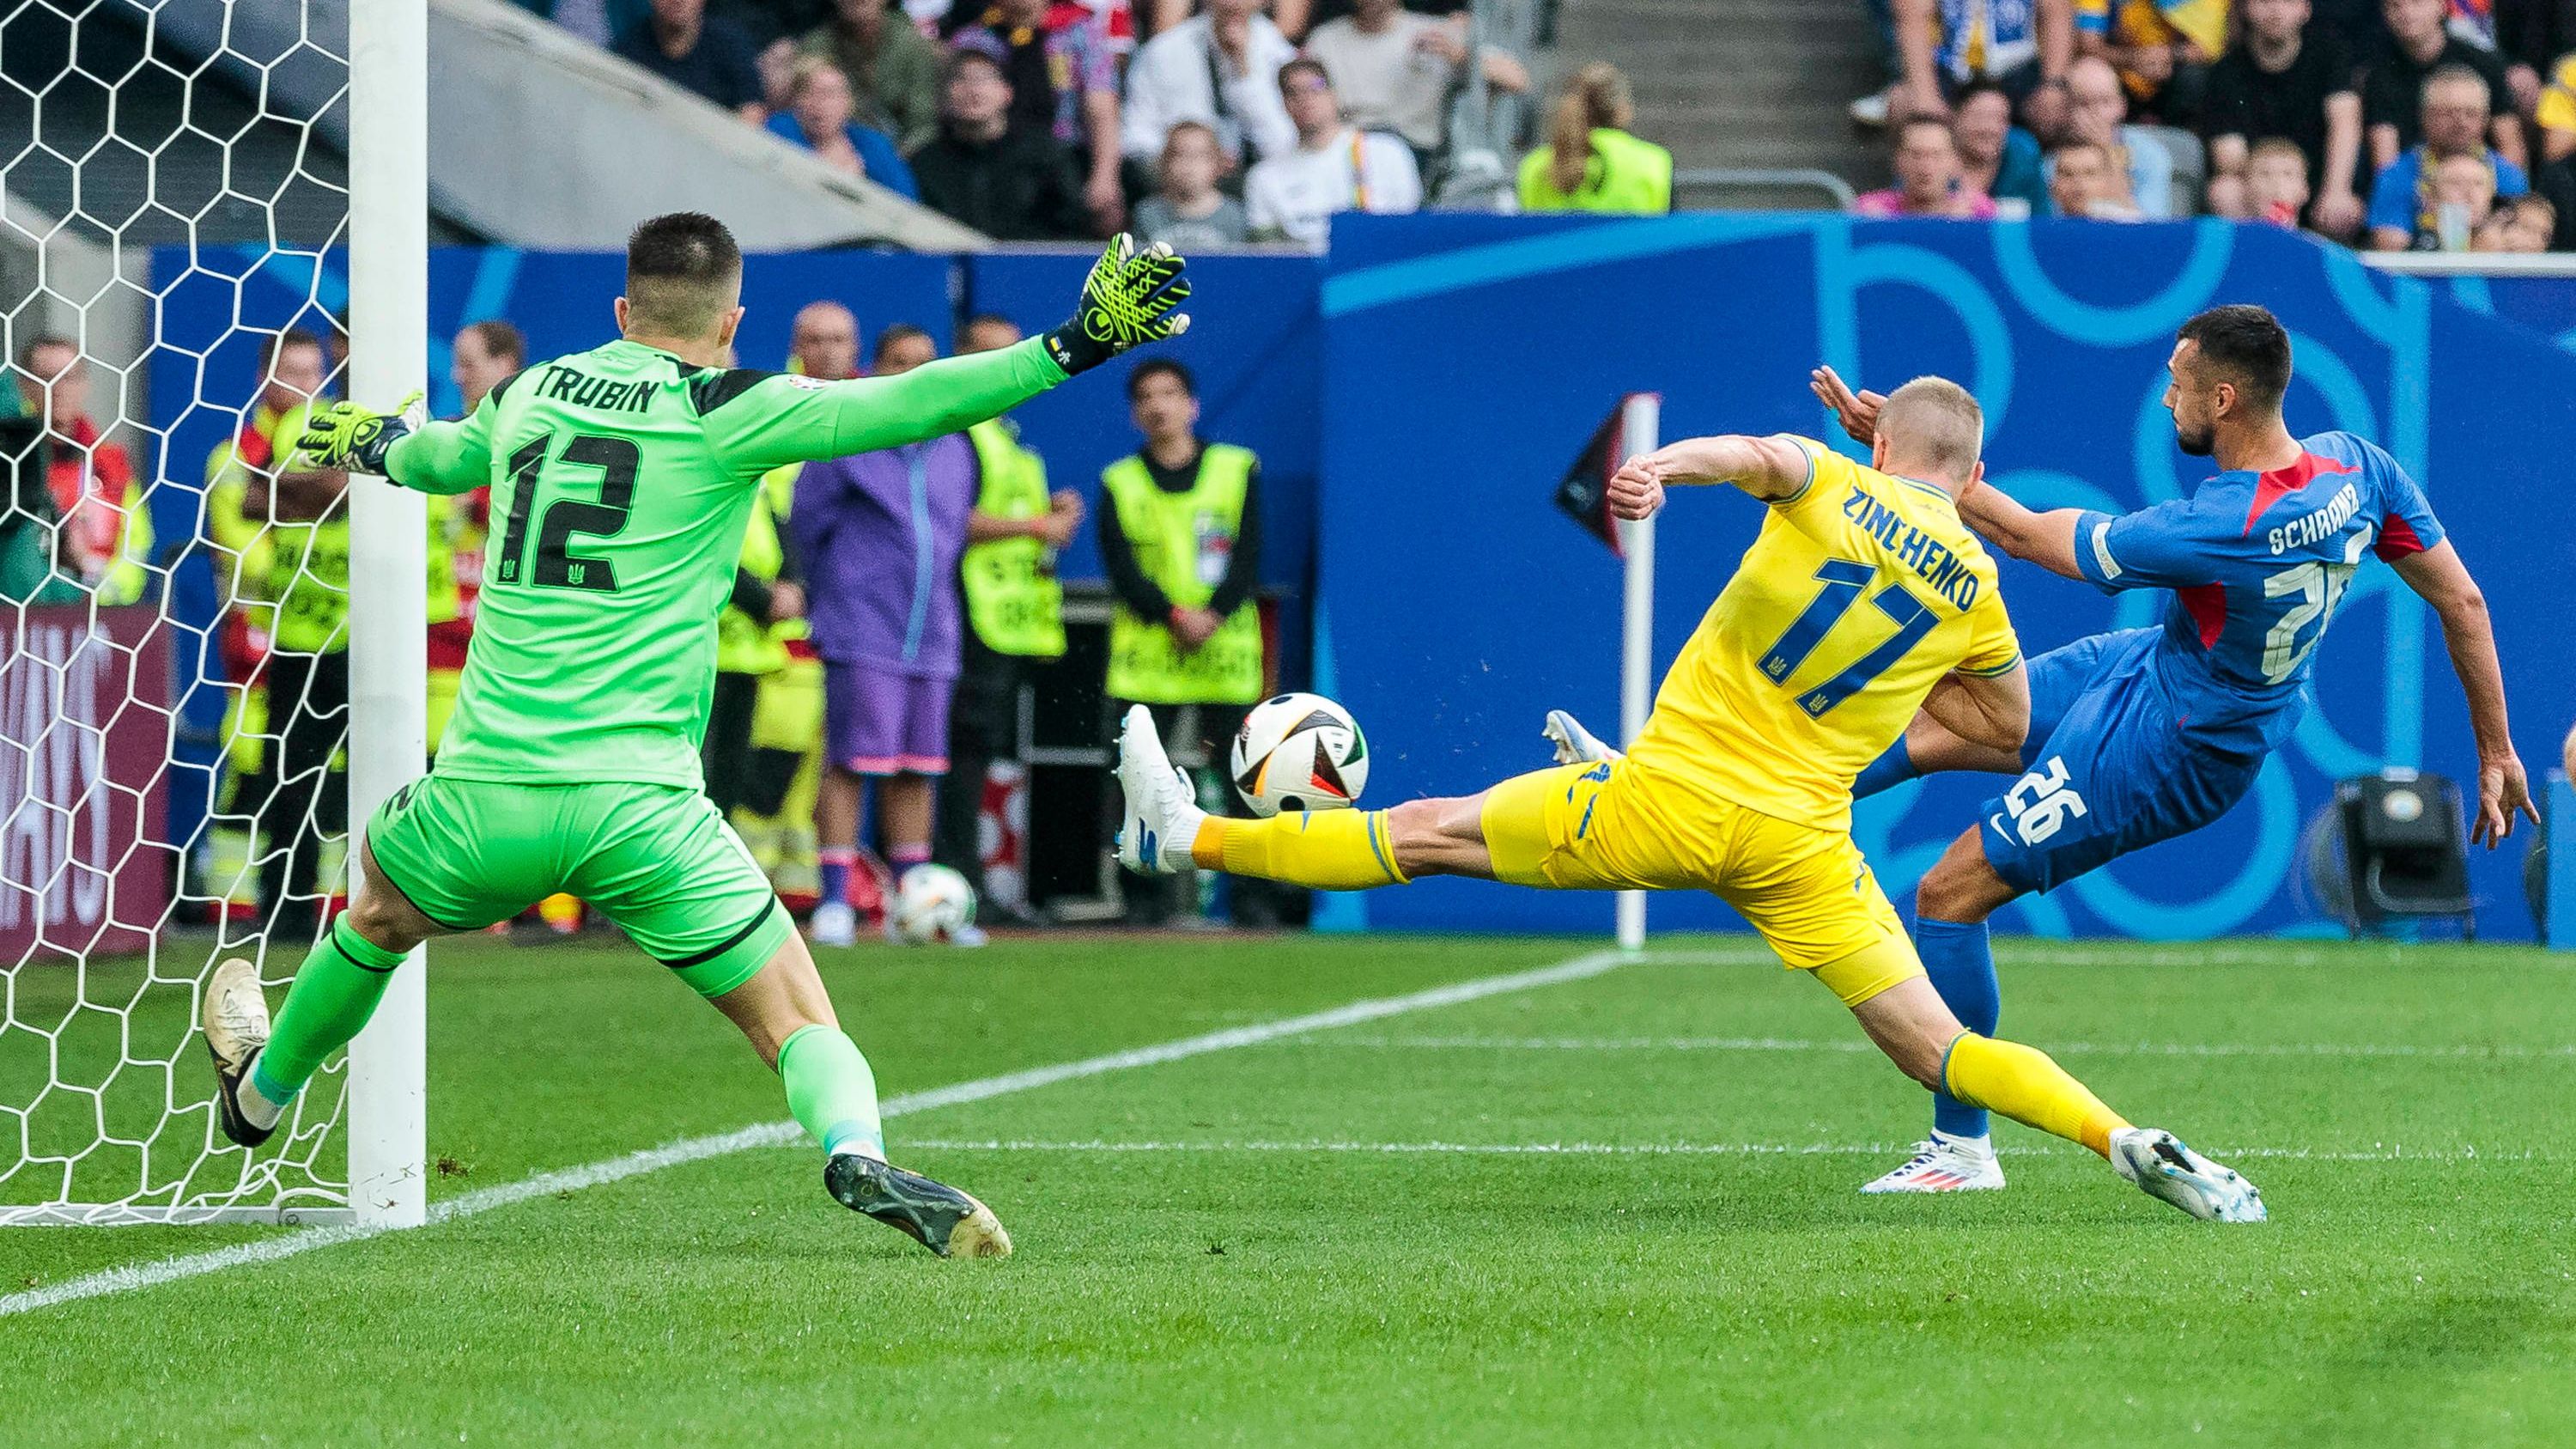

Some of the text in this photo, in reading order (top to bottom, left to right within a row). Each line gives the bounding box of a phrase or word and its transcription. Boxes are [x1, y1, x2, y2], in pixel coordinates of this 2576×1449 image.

[535, 366, 659, 413] TRUBIN
[496, 430, 643, 594] 12
[1843, 485, 1979, 613] ZINCHENKO
[2268, 482, 2360, 557] SCHRANZ
[1755, 557, 1943, 721] 17
[2003, 755, 2088, 848] 26
